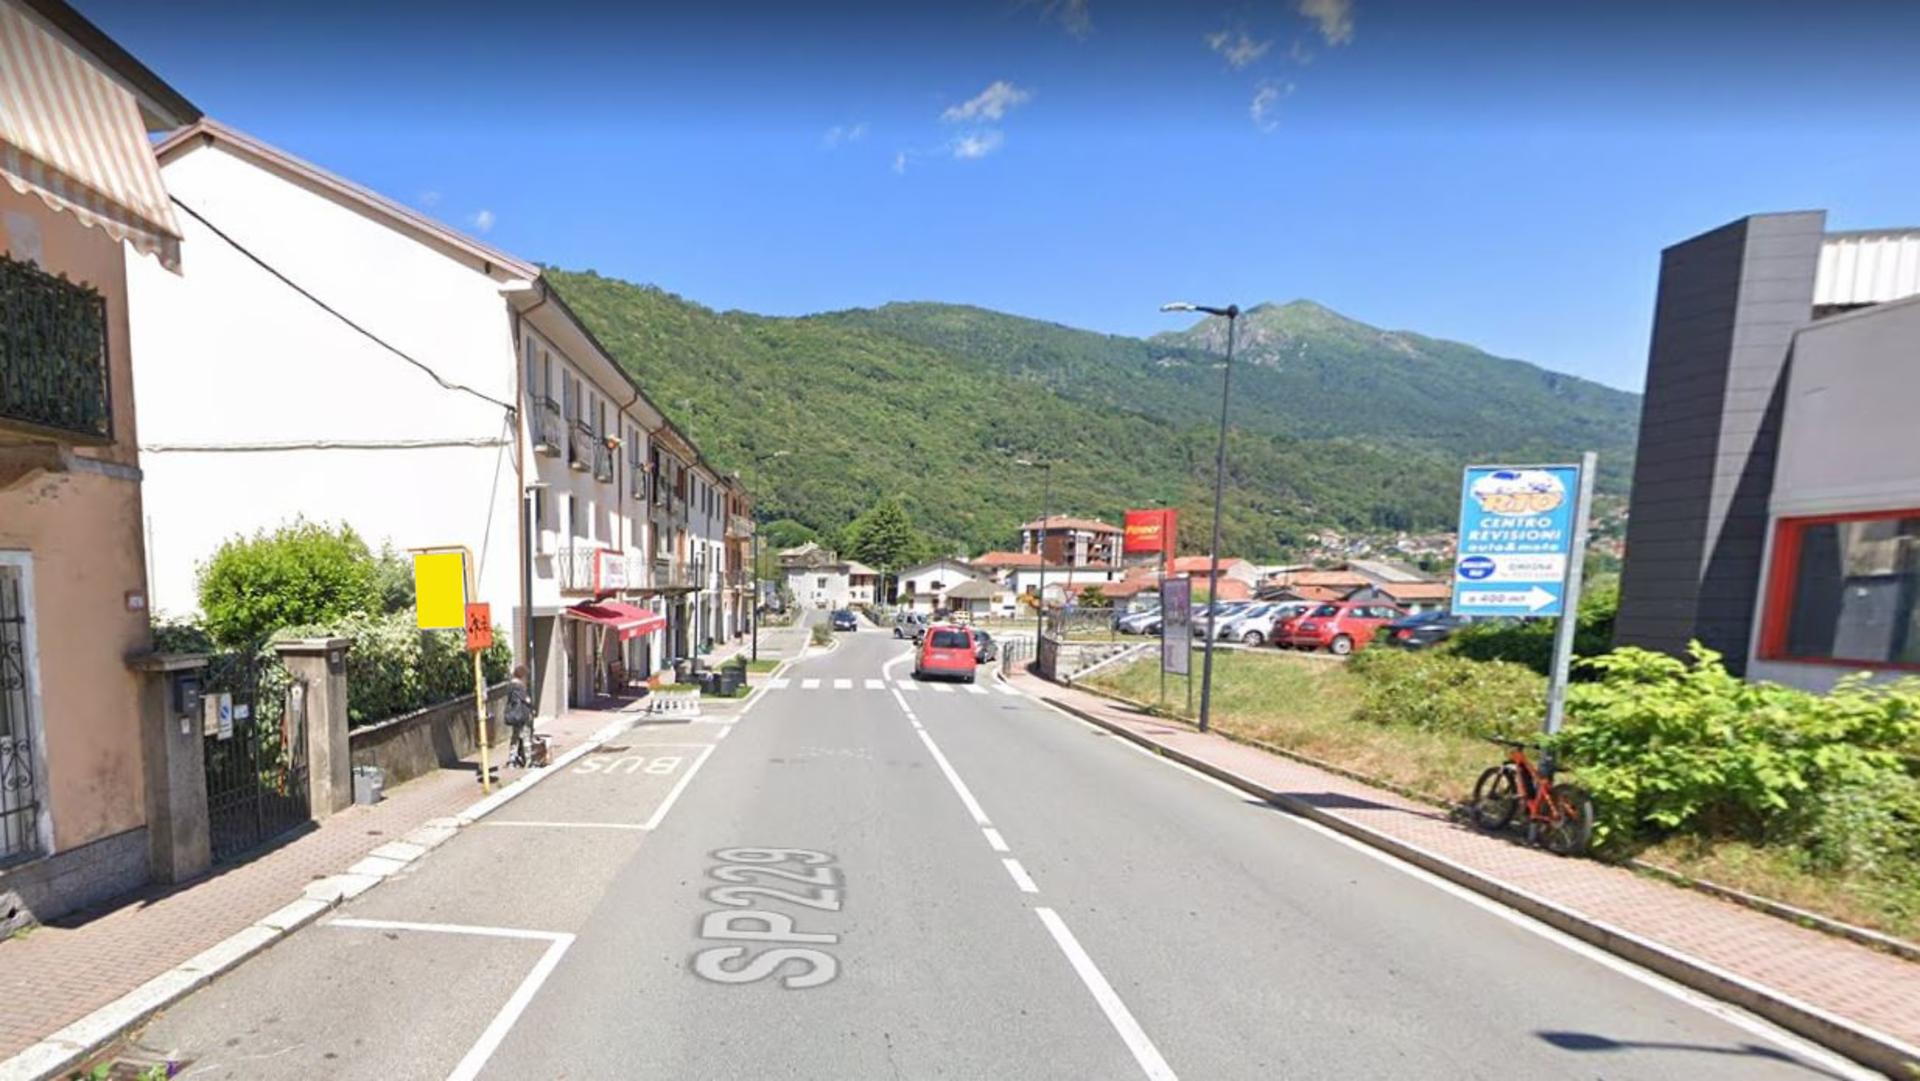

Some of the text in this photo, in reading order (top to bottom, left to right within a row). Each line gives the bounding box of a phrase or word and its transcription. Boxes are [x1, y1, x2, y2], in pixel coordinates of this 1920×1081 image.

[1481, 518, 1552, 528] CENTRO
[1469, 530, 1561, 540] REVISIONI
[571, 756, 679, 774] BUS
